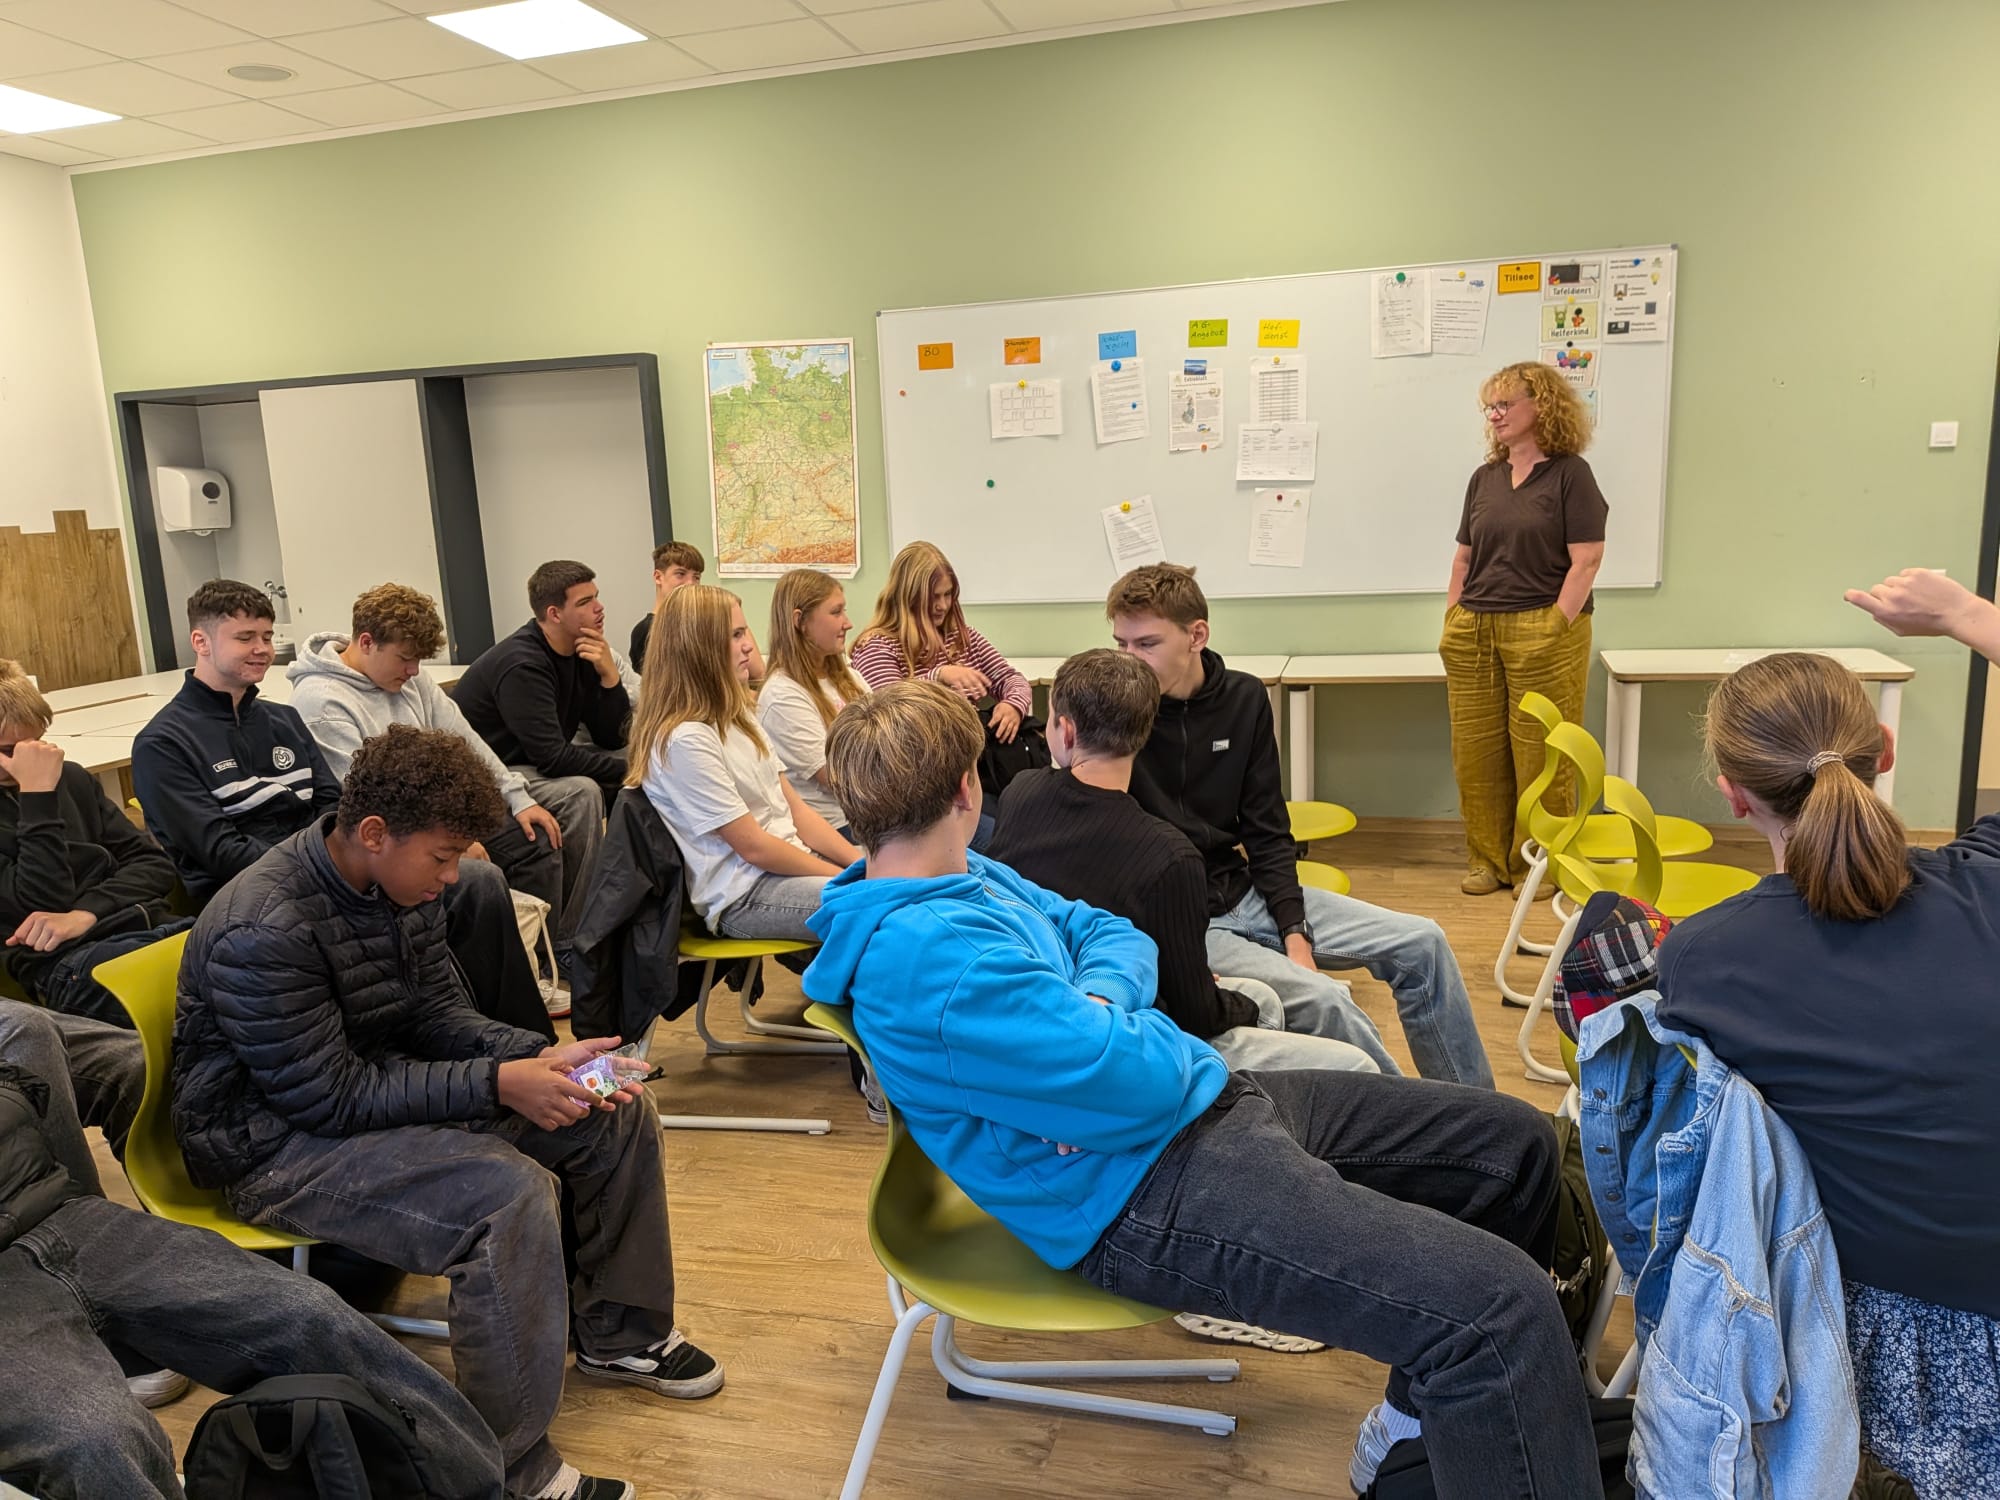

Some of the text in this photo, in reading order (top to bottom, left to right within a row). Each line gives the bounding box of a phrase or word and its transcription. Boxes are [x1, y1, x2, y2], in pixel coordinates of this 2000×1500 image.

[1505, 273, 1535, 283] Titisee
[1553, 287, 1592, 296] Tafeldienst
[1550, 328, 1589, 338] Helferkind
